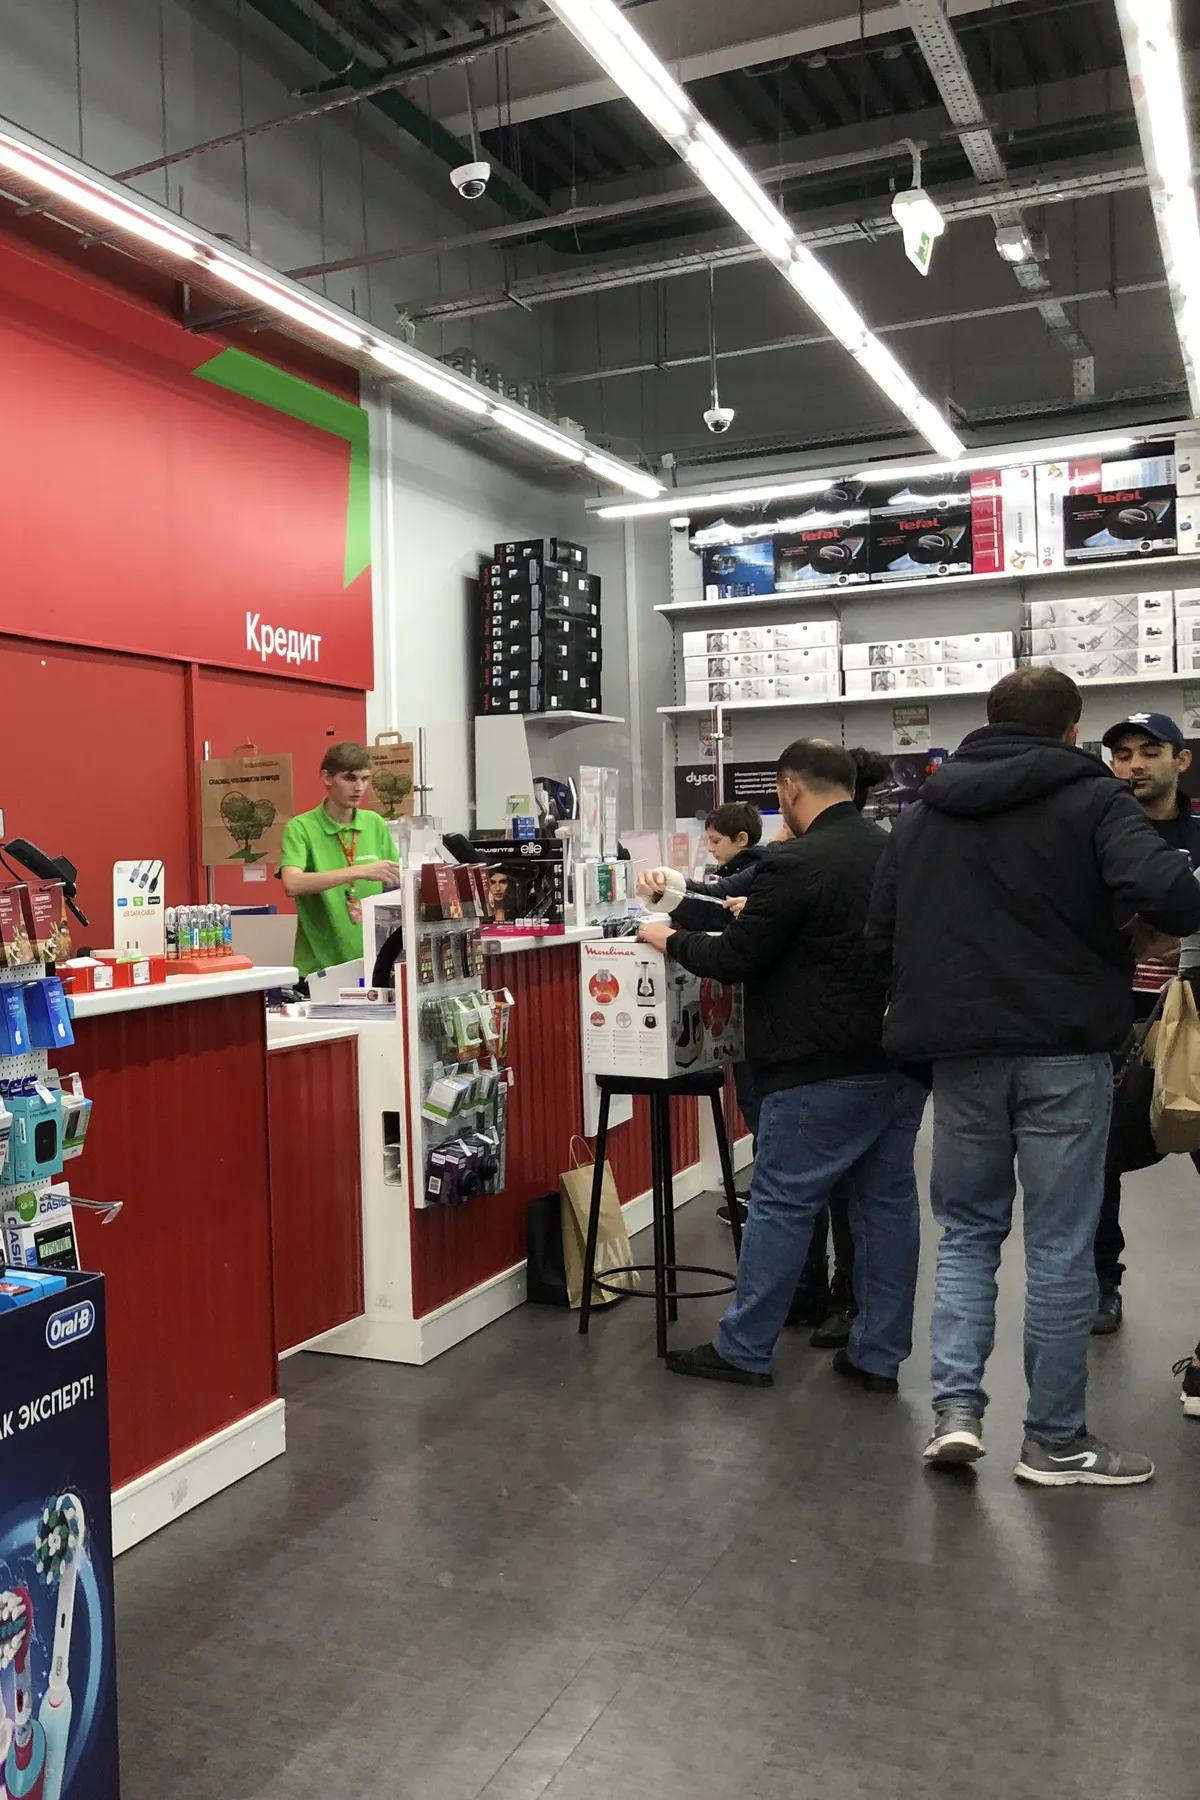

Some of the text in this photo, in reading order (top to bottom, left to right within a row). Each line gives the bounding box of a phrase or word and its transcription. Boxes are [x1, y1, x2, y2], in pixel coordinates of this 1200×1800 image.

[1095, 490, 1144, 505] Tefal
[898, 518, 940, 531] Tefal
[800, 528, 841, 542] Tefal
[246, 611, 321, 664] Кредит
[686, 771, 716, 786] dyso
[584, 944, 636, 957] Moulinex
[39, 1196, 68, 1214] CASIO
[7, 1216, 21, 1266] CASI
[50, 1308, 90, 1342] Oral-B
[18, 1374, 94, 1431] ЭКСПЕРТ!
